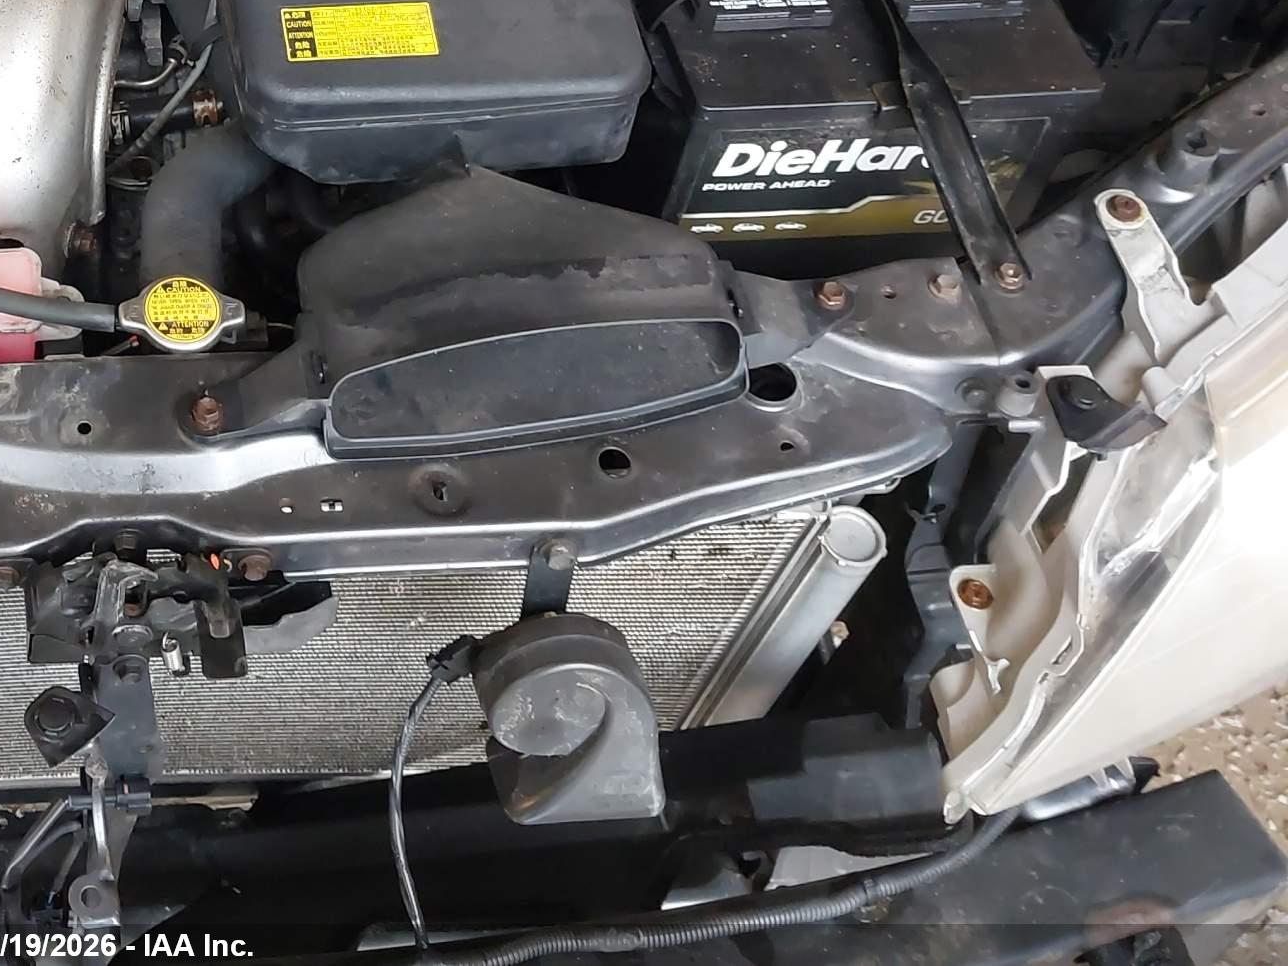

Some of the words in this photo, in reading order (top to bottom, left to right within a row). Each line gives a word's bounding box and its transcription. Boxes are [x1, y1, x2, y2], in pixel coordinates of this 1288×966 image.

[287, 20, 312, 28] CAUTION
[702, 182, 766, 192] POWER
[769, 179, 832, 189] AHEAD
[913, 209, 949, 224] GO
